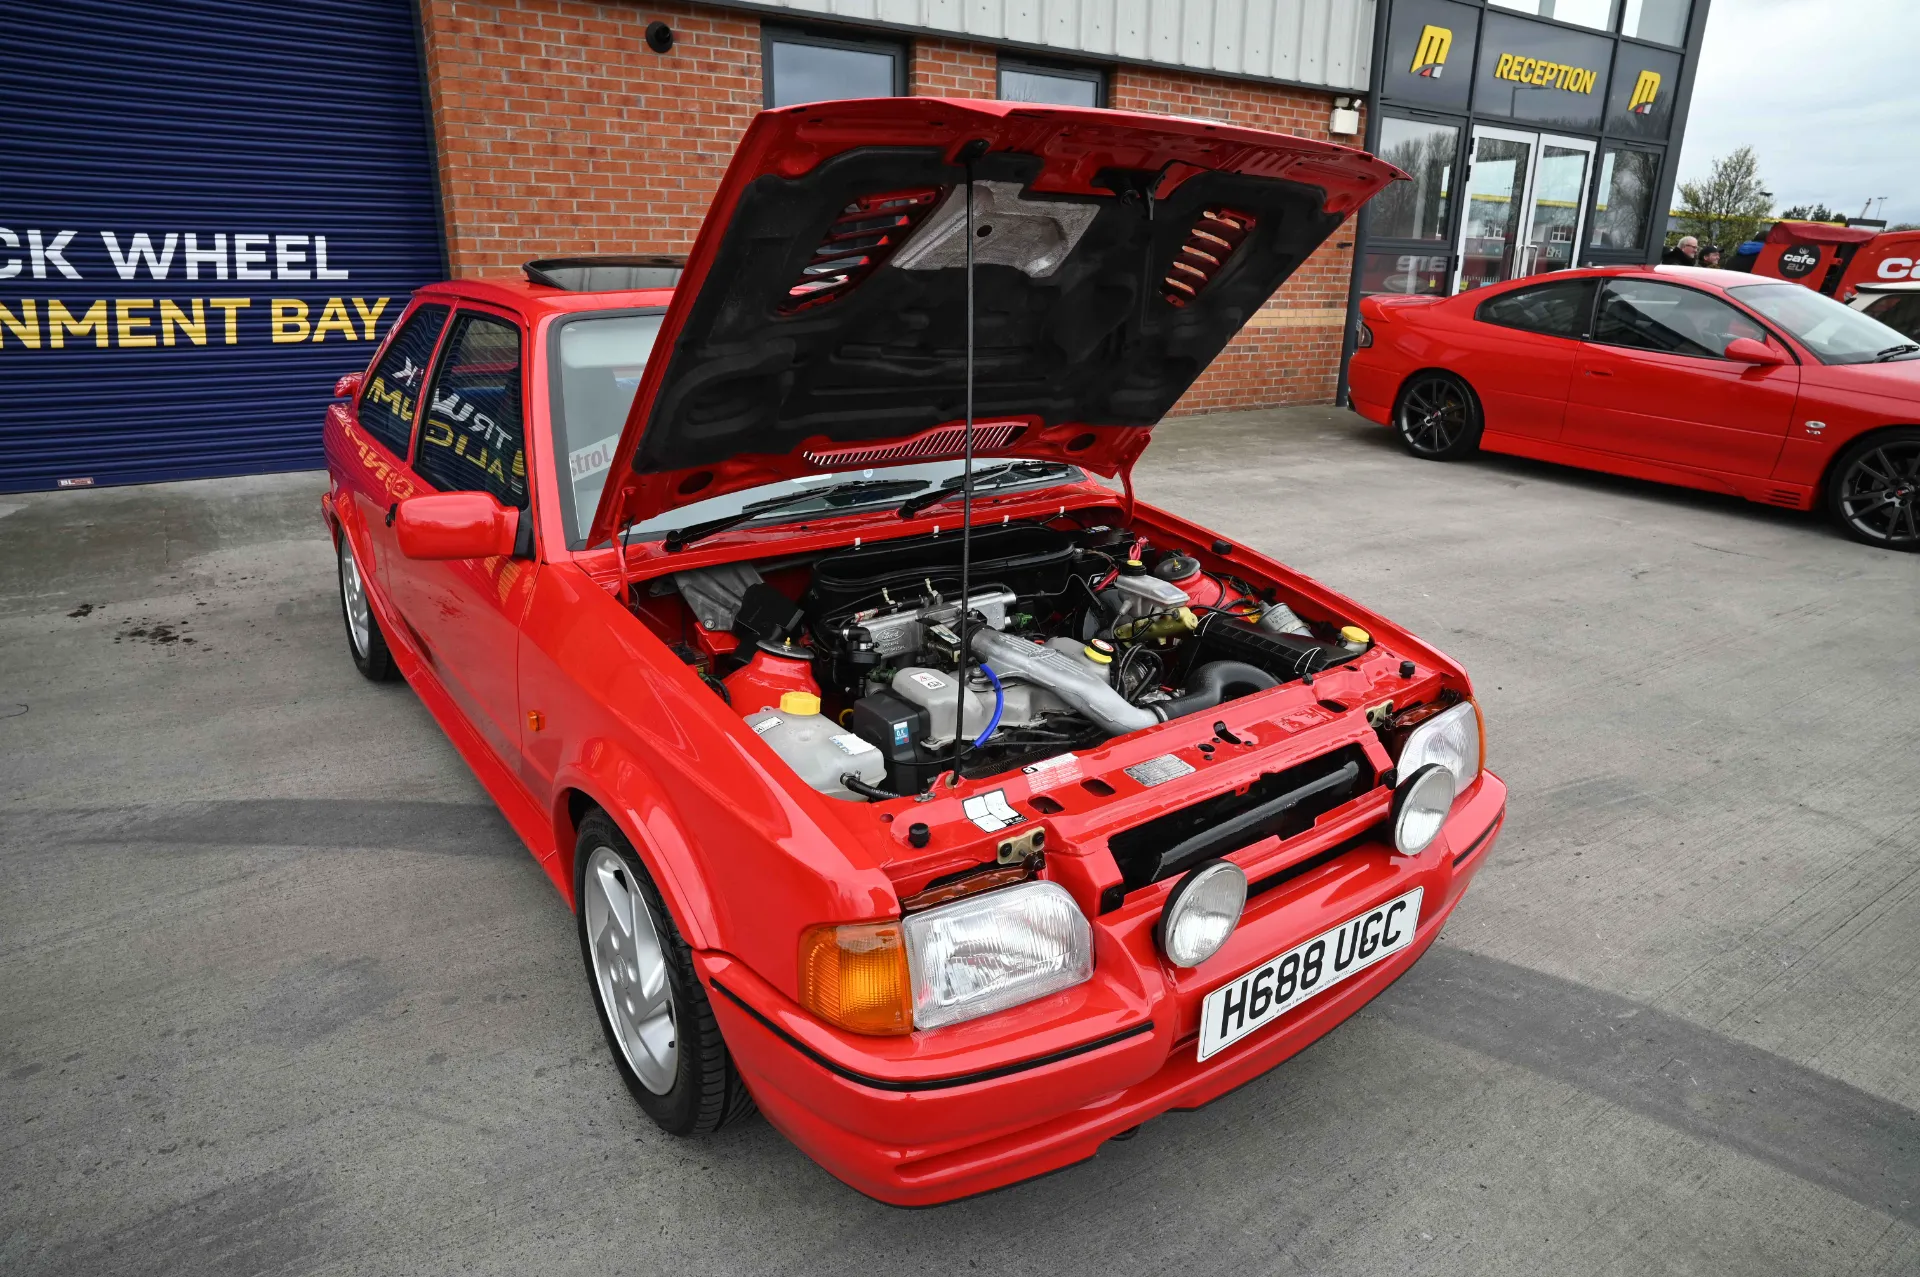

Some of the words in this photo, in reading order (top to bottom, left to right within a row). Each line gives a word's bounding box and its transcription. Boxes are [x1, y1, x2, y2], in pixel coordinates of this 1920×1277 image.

[1494, 52, 1598, 95] RECEPTION
[100, 231, 349, 280] WHEEL
[1783, 253, 1816, 265] cafe
[271, 297, 391, 343] BAY
[1219, 939, 1326, 1040] H688
[1334, 900, 1407, 973] UGC
